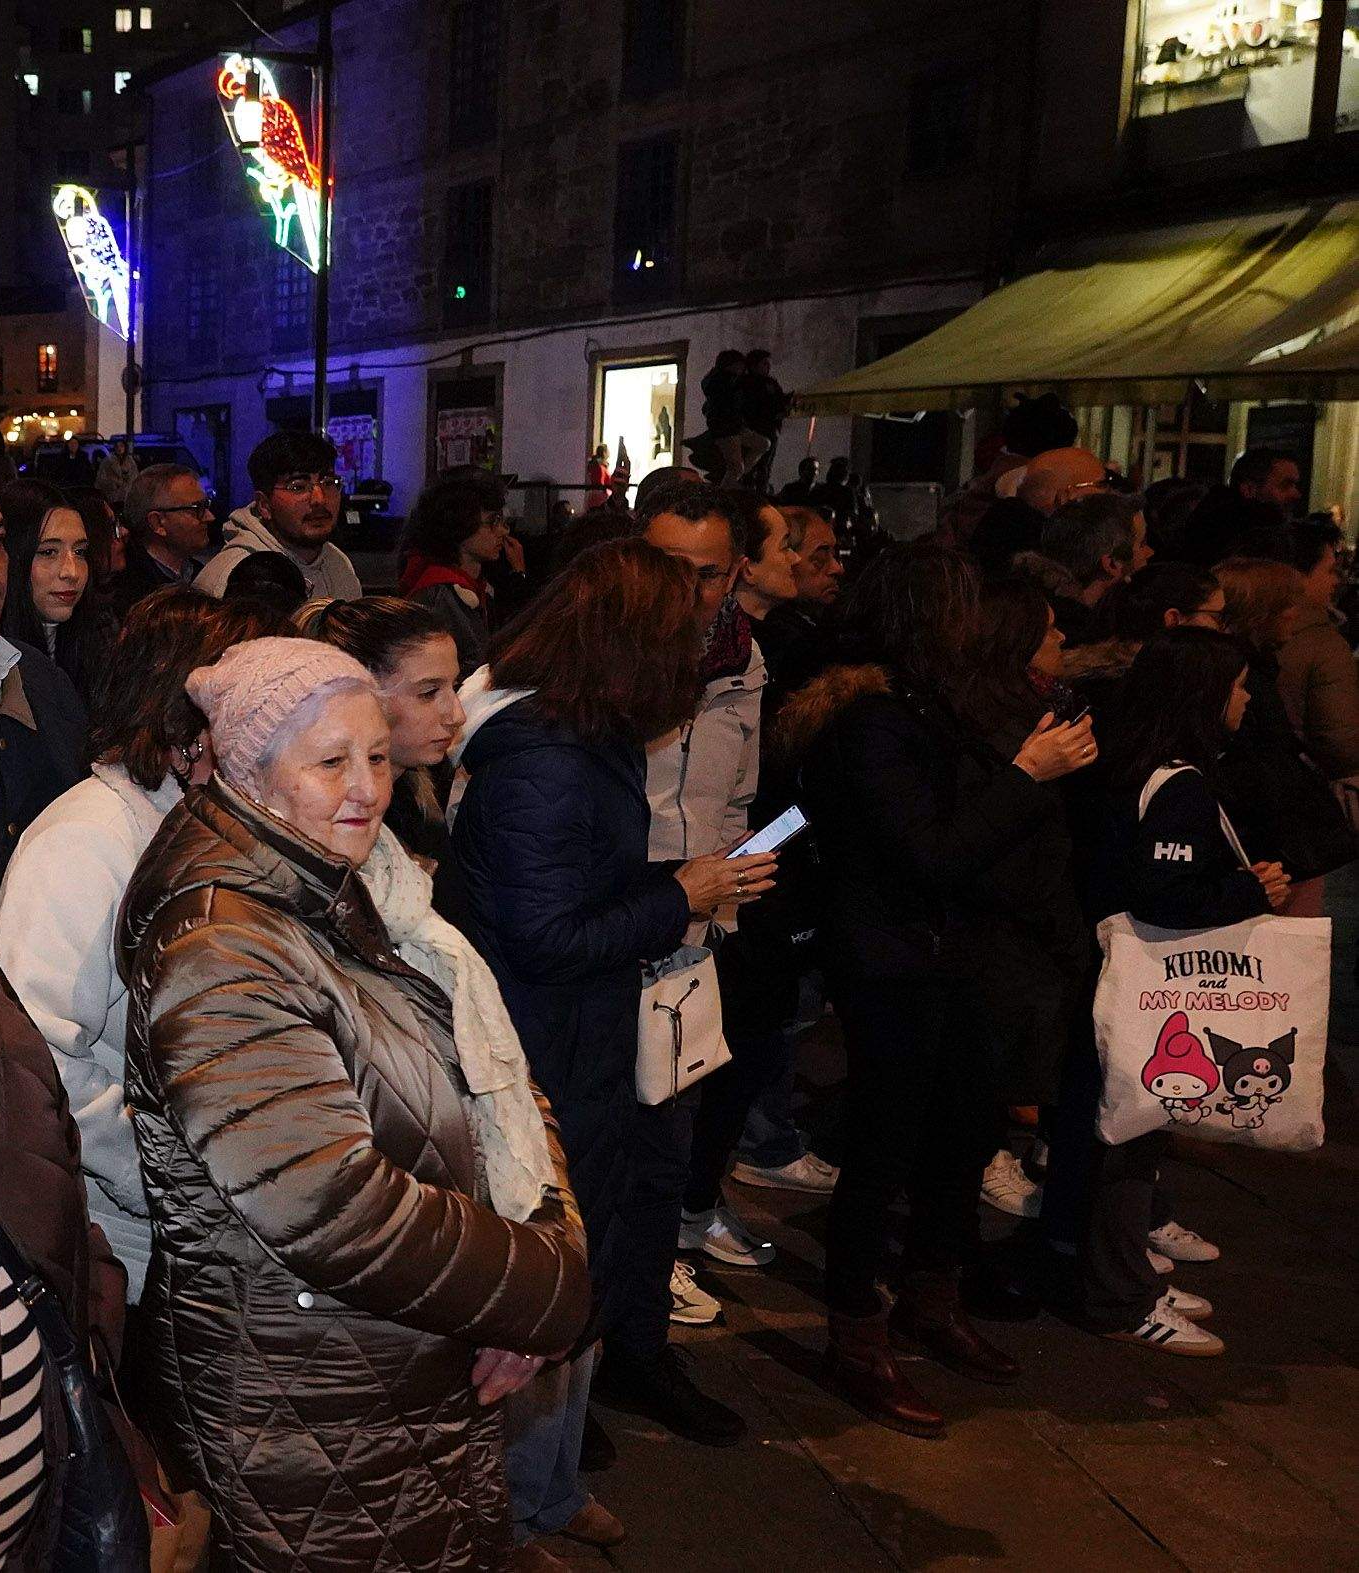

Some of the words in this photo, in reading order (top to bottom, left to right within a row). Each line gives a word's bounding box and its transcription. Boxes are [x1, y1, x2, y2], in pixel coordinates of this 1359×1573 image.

[1153, 841, 1193, 862] HH
[1162, 949, 1264, 984] KUROMI
[1198, 977, 1228, 989] and
[1139, 990, 1181, 1010] MY
[1185, 990, 1290, 1011] MELODY
